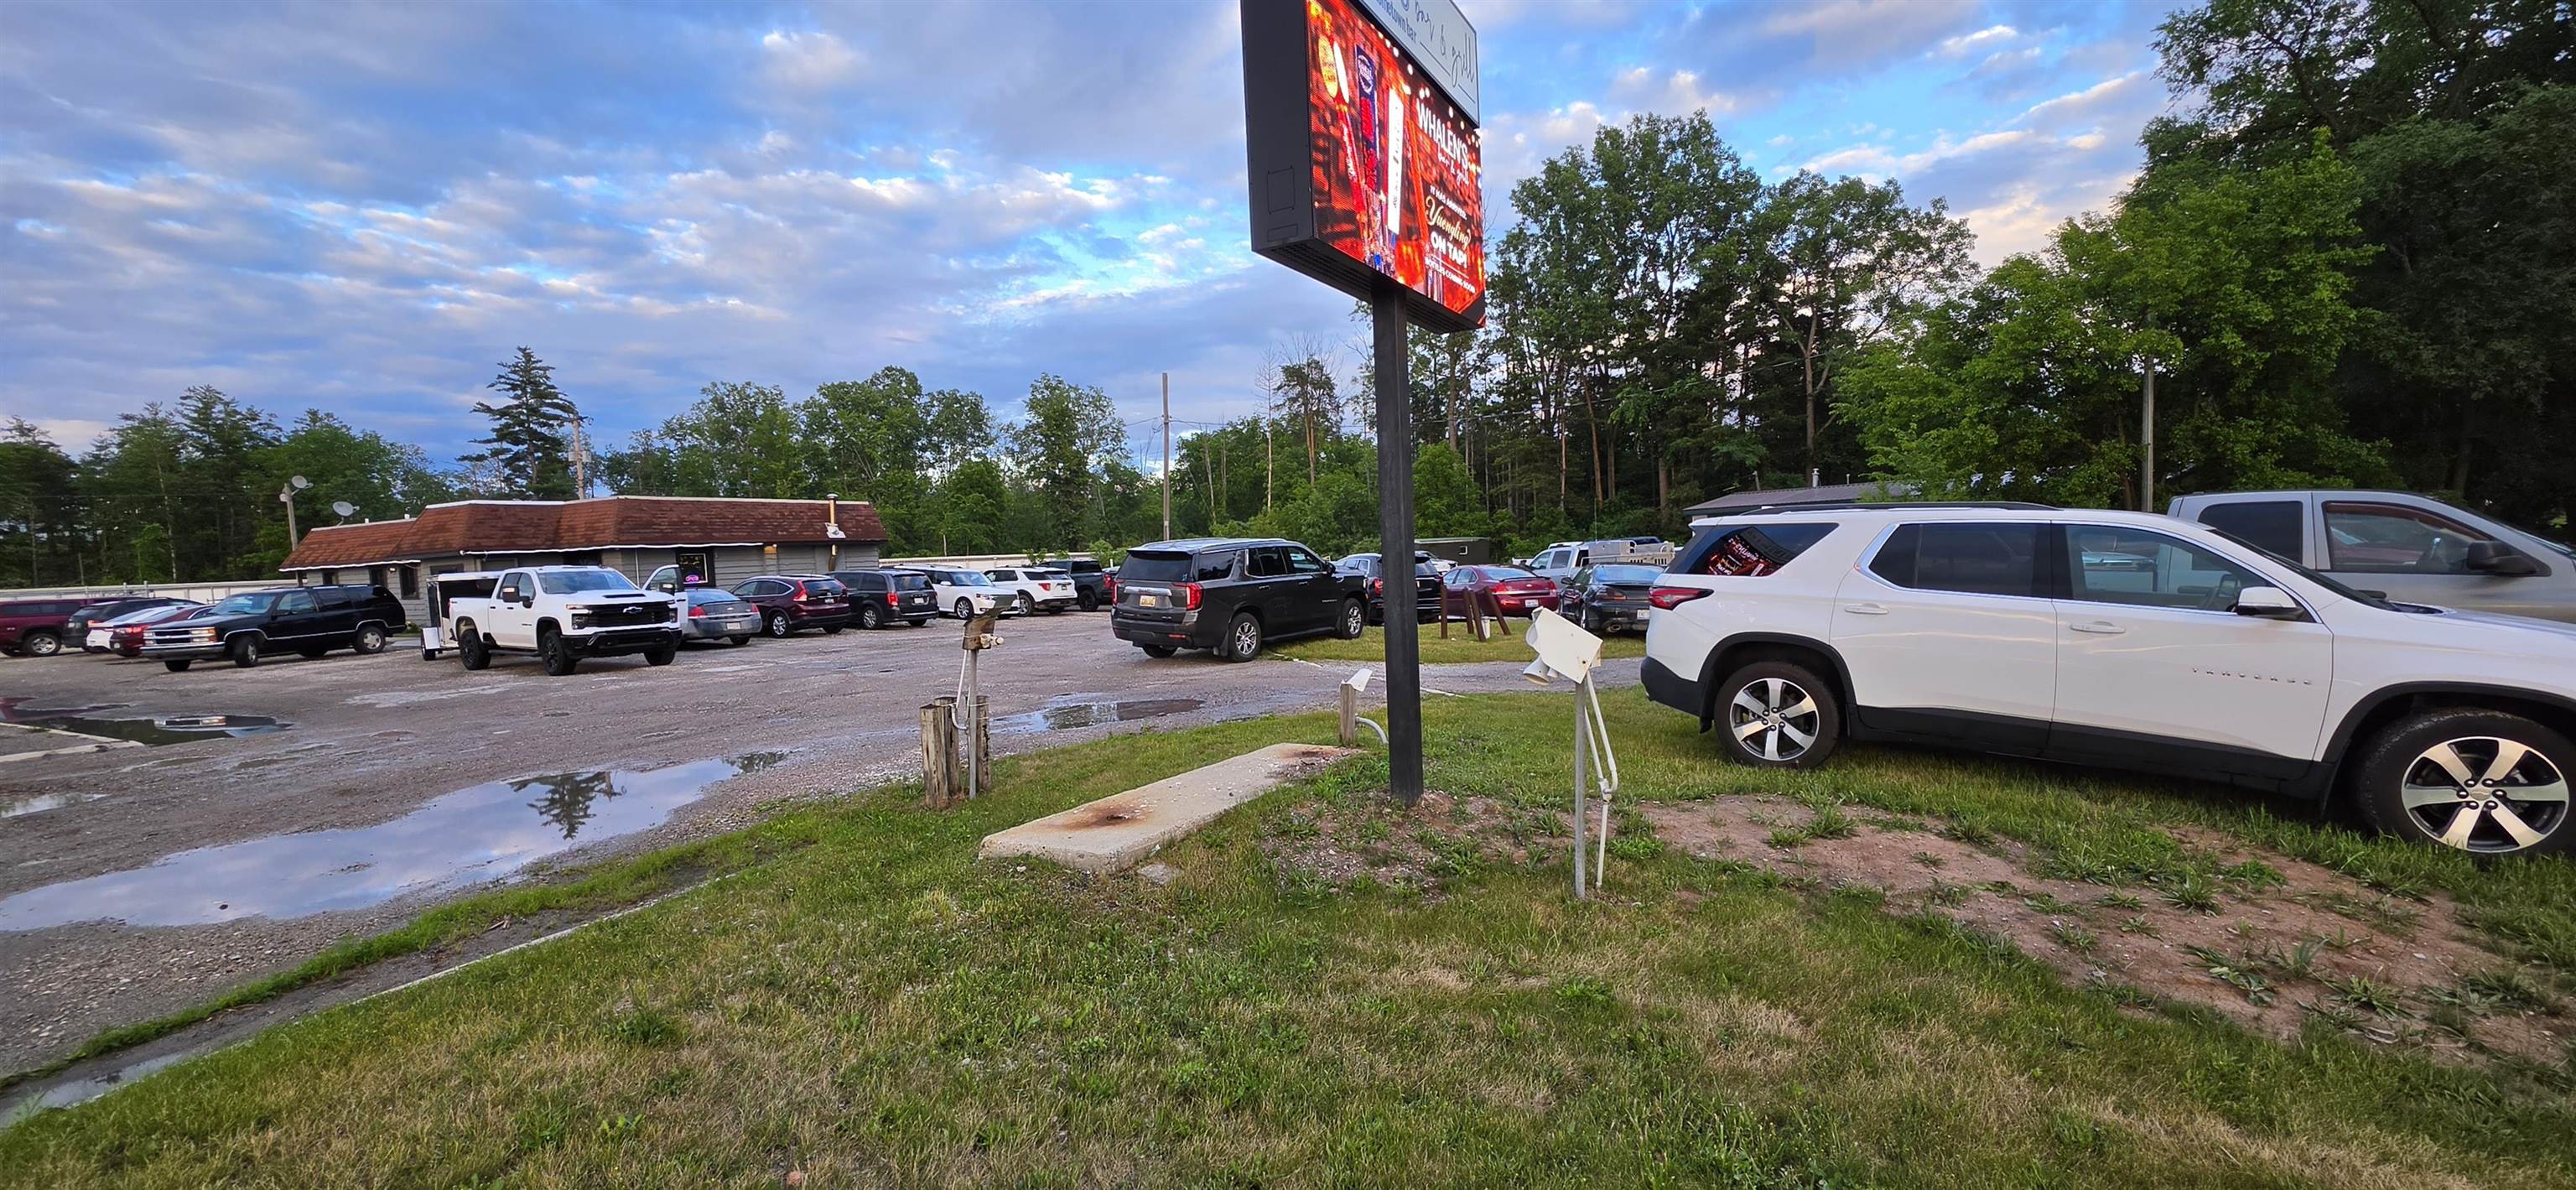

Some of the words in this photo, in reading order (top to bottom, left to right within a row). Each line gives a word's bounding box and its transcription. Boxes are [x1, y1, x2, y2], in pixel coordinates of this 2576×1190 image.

[1416, 97, 1468, 170] WHALEN'S
[1426, 195, 1471, 251] Yuengling
[1431, 231, 1446, 254] ON
